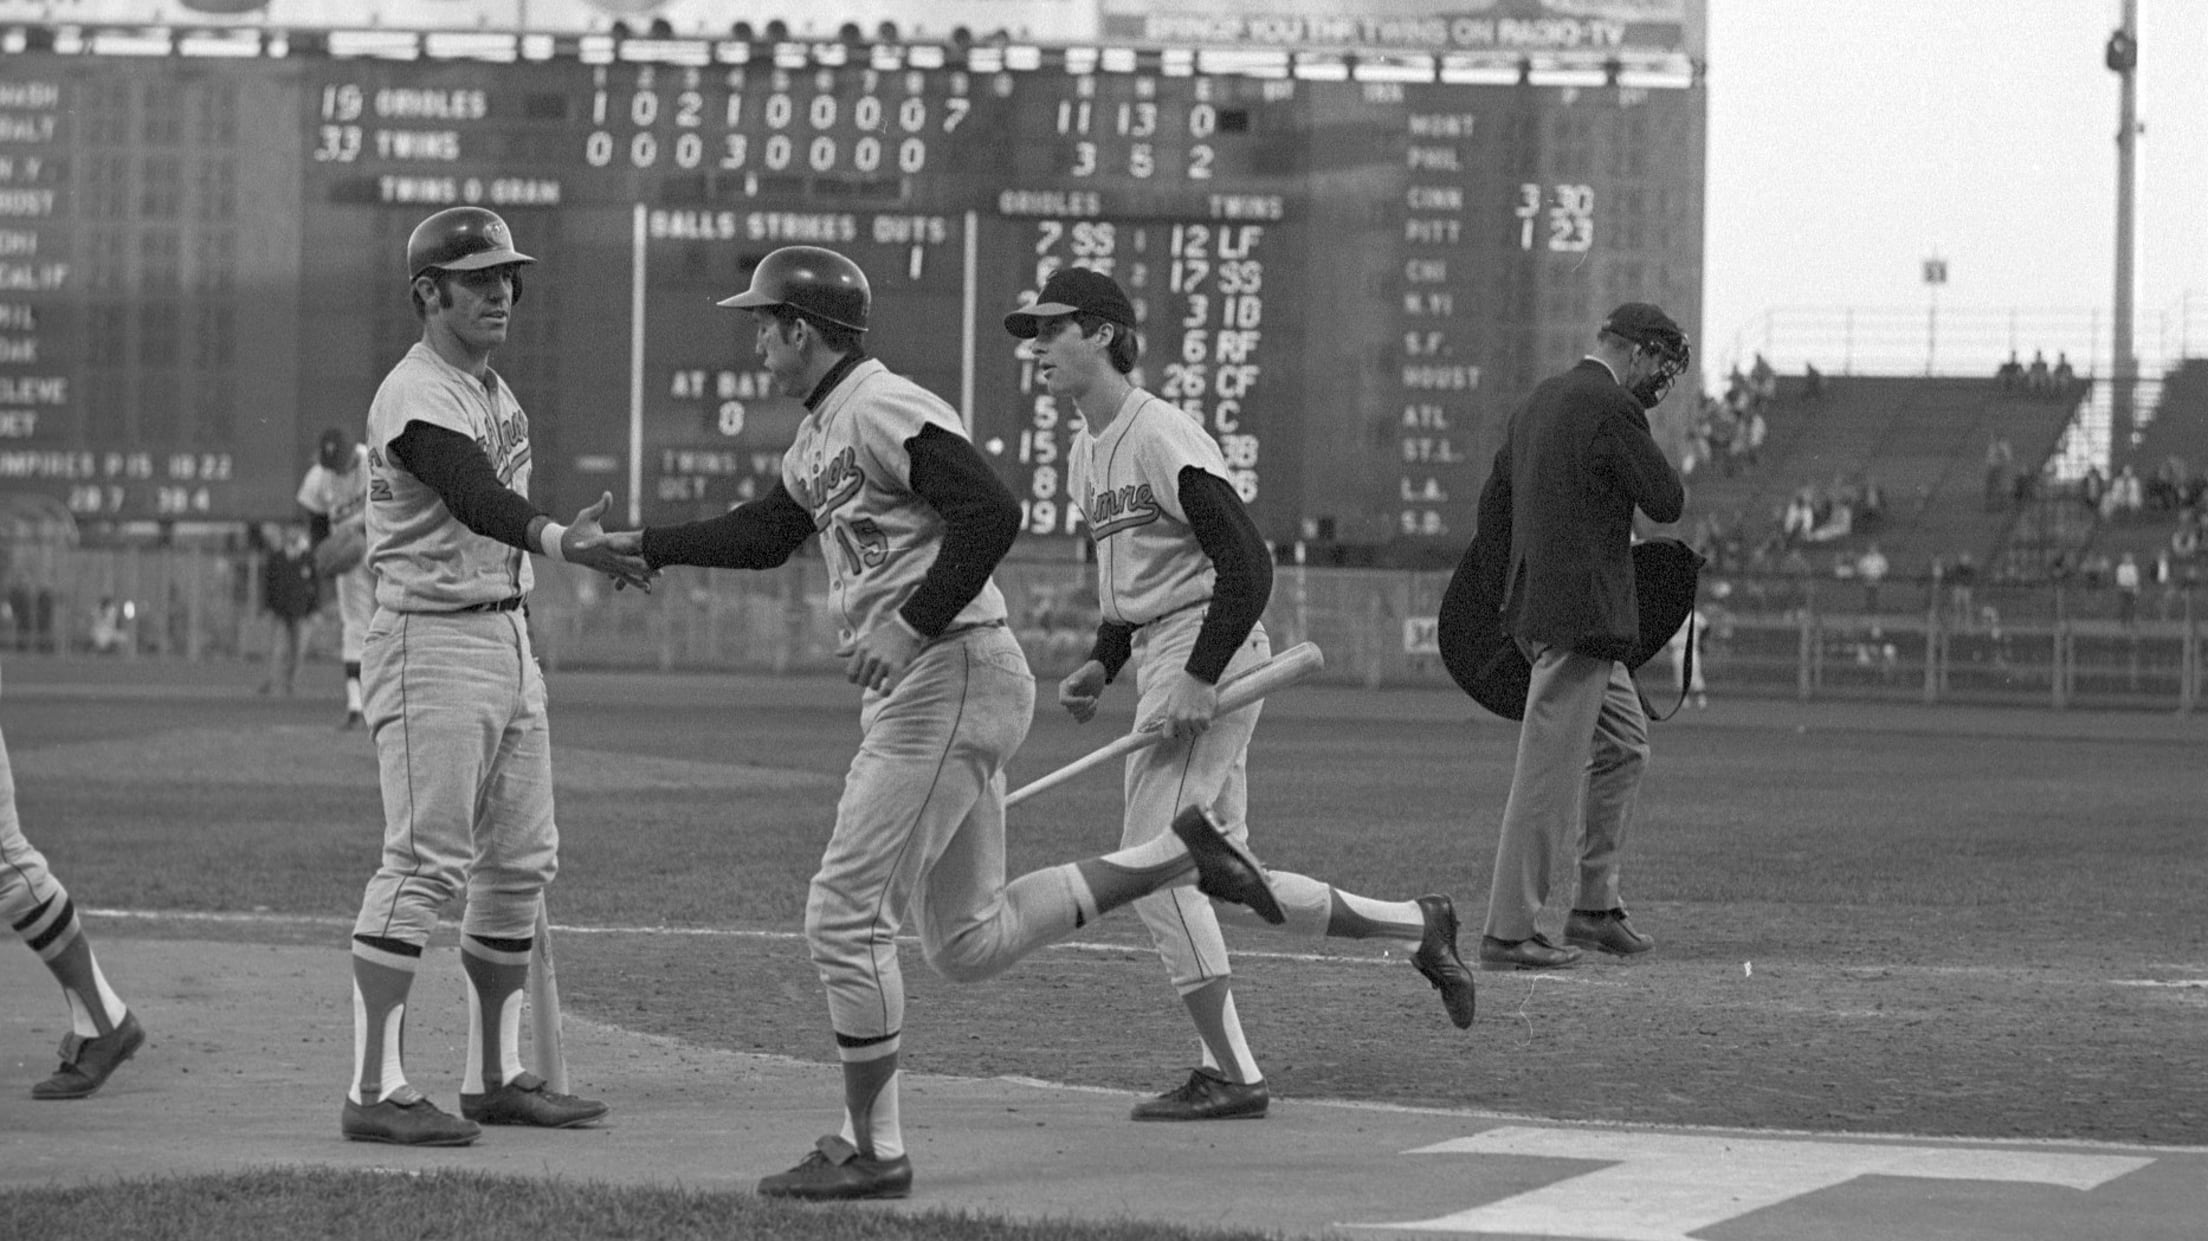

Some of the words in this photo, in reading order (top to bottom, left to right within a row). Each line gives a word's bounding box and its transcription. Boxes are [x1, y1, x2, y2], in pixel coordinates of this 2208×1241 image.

[1452, 17, 1495, 46] ON
[321, 83, 363, 121] 19
[375, 88, 487, 119] ORIOLES
[592, 90, 607, 125] 1
[631, 91, 658, 126] 0
[675, 91, 703, 127] 2
[726, 93, 741, 127] 1
[765, 94, 792, 129] 0
[810, 94, 837, 130] 0
[855, 96, 881, 131] 0
[900, 97, 926, 132] 0
[943, 97, 970, 133] 7
[1056, 100, 1091, 134] 11
[1117, 102, 1157, 136] 13
[1189, 104, 1216, 138] 0
[314, 125, 362, 162] 33
[375, 129, 460, 160] TWINS
[586, 131, 613, 167] 0
[631, 132, 657, 168] 0
[675, 133, 702, 169] 0
[719, 134, 747, 169] 3
[765, 134, 792, 170] 0
[810, 135, 837, 171] 0
[855, 136, 881, 171] 0
[900, 138, 926, 173] 0
[1070, 141, 1097, 177] 3
[1188, 144, 1214, 179] 2
[380, 175, 456, 203] TWINS
[1209, 193, 1283, 219] TWINS
[1515, 183, 1541, 218] 3
[1550, 184, 1595, 219] 30
[650, 209, 735, 240] BALLS
[746, 211, 857, 242] STRIKES
[873, 214, 946, 244] OUTS
[1036, 221, 1062, 255] 7
[1070, 222, 1116, 257] SS
[1170, 224, 1210, 259] 12
[1218, 225, 1264, 260] LF
[1521, 219, 1534, 250] 1
[1549, 218, 1594, 251] 23
[910, 245, 923, 280] 1
[1170, 259, 1210, 294] 17
[1218, 260, 1263, 294] SS
[1183, 294, 1208, 328] 3
[1183, 329, 1208, 363] 6
[1216, 329, 1261, 363] RF
[671, 369, 705, 398] AT
[1162, 363, 1208, 398] 26
[1216, 364, 1260, 398] CF
[719, 400, 744, 436] 0
[1215, 400, 1240, 433] C
[1019, 428, 1058, 465] 15
[1033, 465, 1058, 499] 8
[1019, 500, 1057, 535] 19
[834, 516, 889, 576] 15
